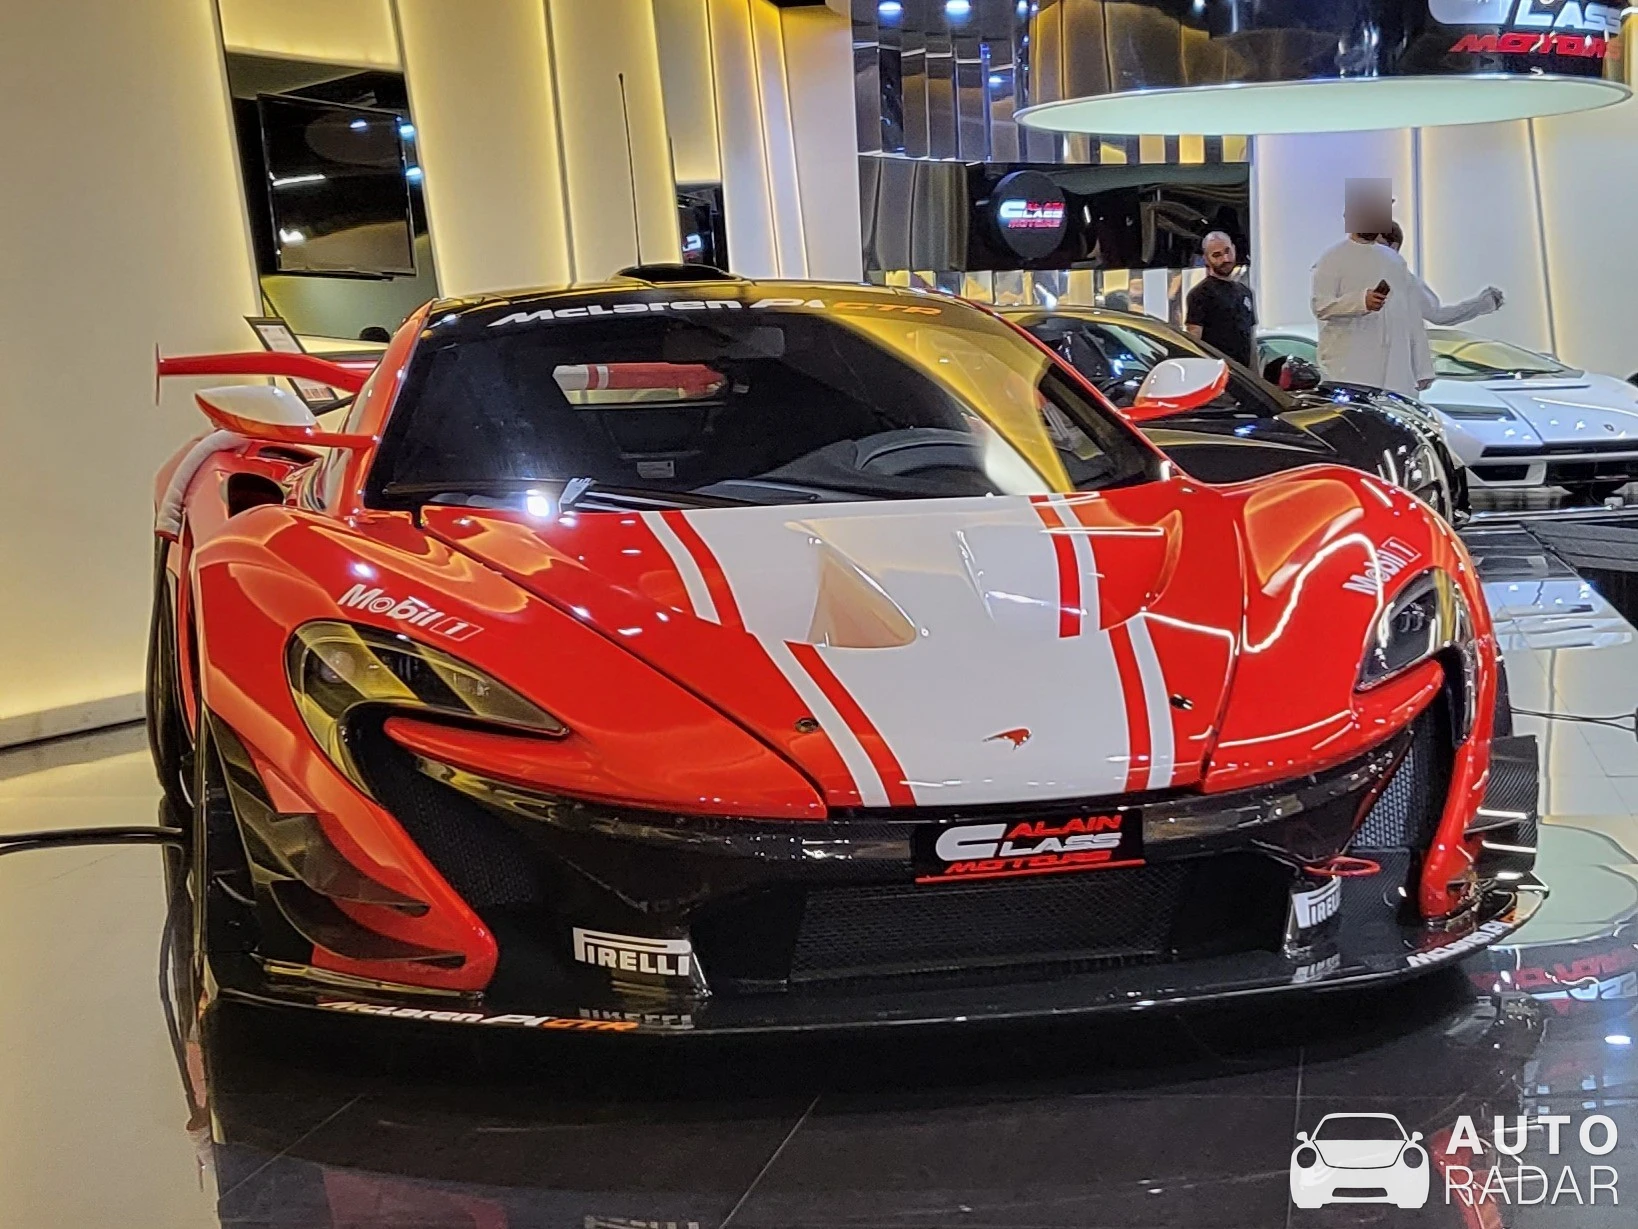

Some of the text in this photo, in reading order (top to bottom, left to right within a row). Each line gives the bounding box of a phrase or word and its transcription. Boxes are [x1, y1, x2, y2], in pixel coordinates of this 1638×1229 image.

[337, 583, 444, 628] Mobil
[935, 823, 1123, 862] CLASS
[944, 850, 1112, 874] MOTORS
[572, 927, 691, 976] PIRELLI
